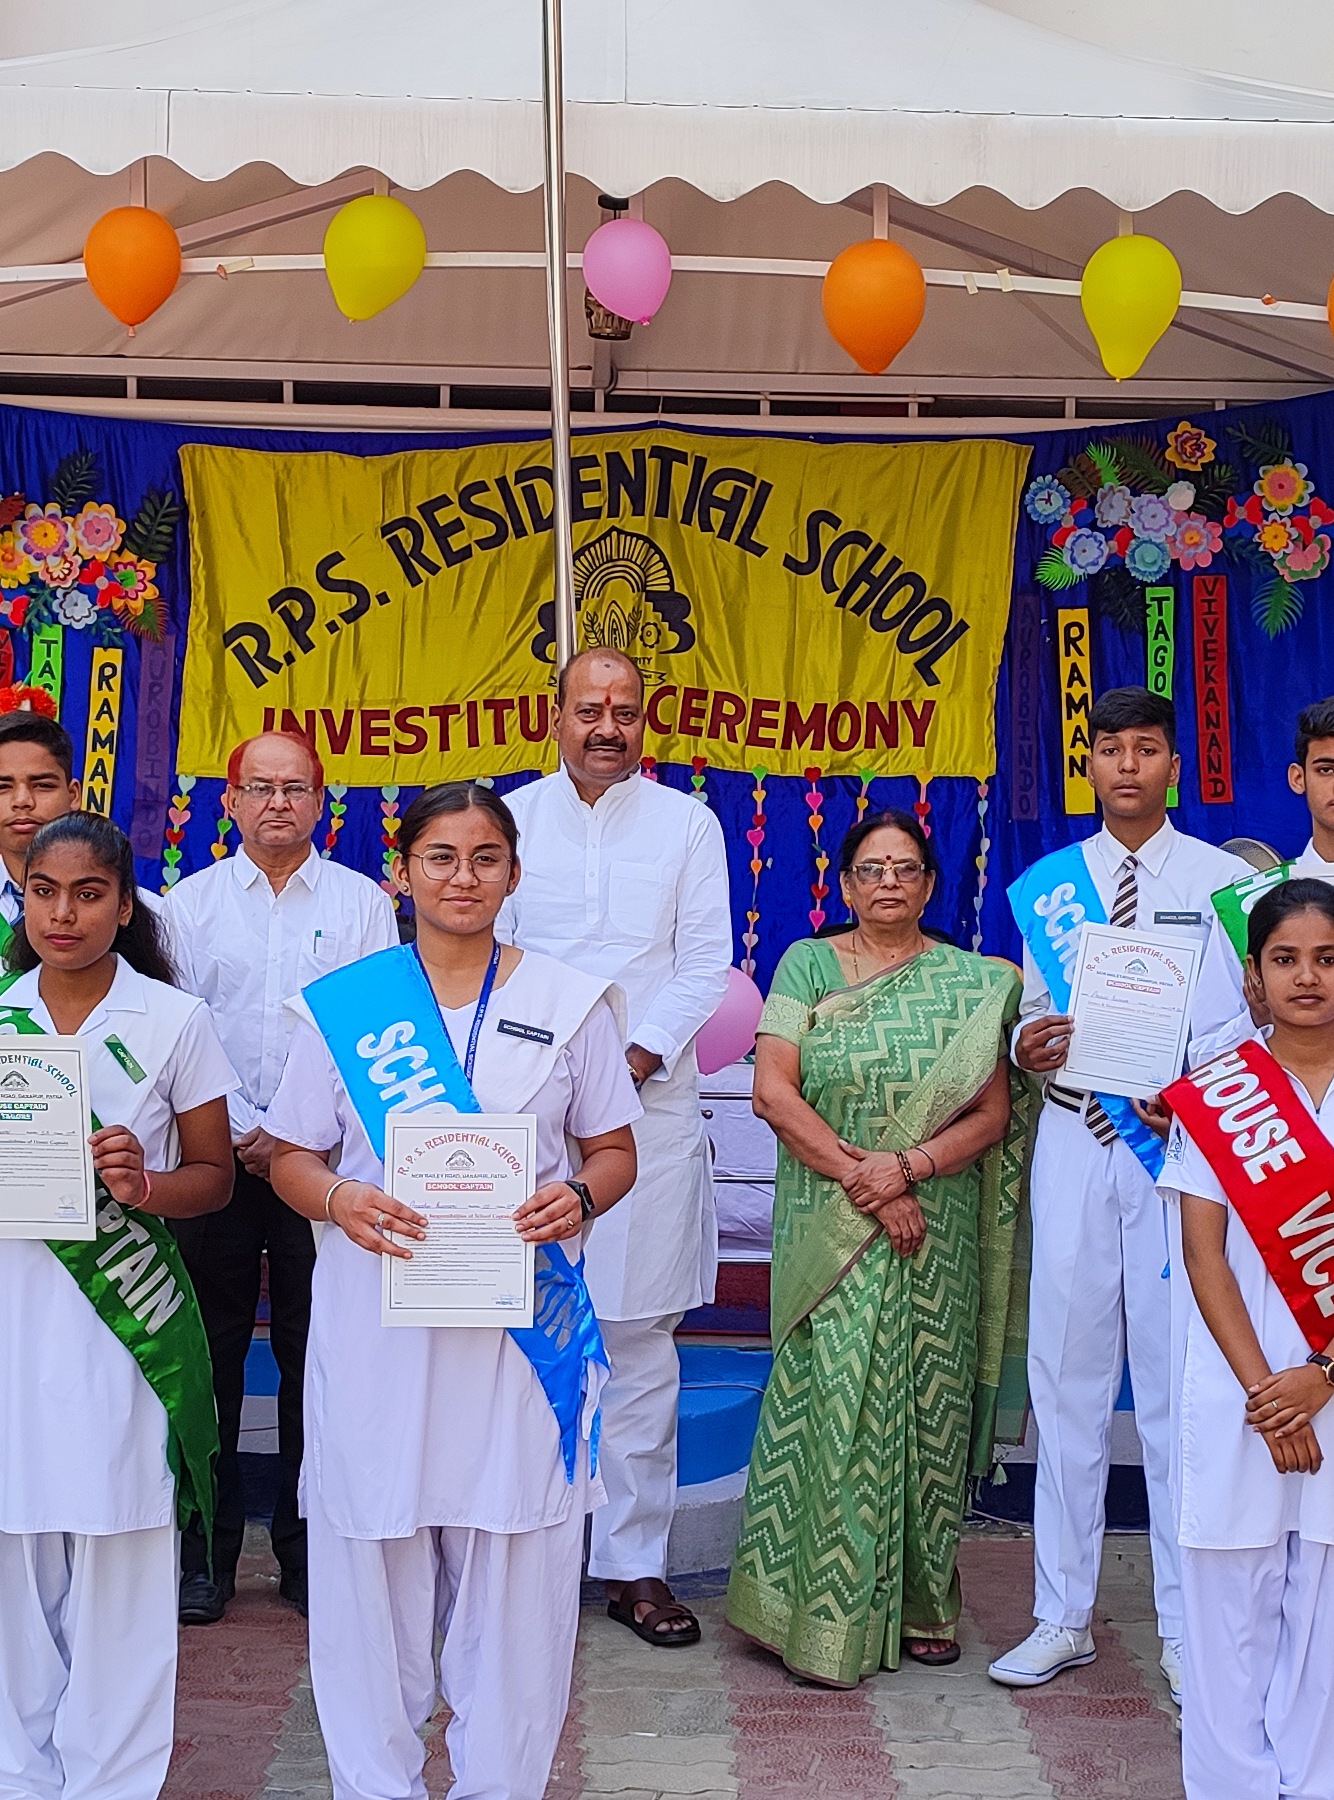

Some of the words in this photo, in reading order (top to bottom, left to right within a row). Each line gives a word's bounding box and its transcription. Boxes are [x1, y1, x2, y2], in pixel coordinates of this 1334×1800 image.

[223, 551, 391, 688] R.P.S.
[380, 445, 773, 586] RESIDENTIAL
[783, 509, 970, 687] SCHOOL
[1063, 621, 1090, 778] RAMAN
[1150, 596, 1171, 693] TAGO
[1200, 578, 1226, 797] VIVEKANAND
[87, 662, 117, 812] RAMAN
[262, 695, 556, 756] INVESTITU
[646, 685, 936, 752] CEREMONY
[1033, 882, 1086, 985] SCH
[45, 1064, 78, 1097] SCHOOL
[356, 1021, 458, 1113] SCH
[1187, 1050, 1306, 1183] HOUSE
[425, 1133, 490, 1149] RESIDENTIAL
[492, 1143, 524, 1176] SCHOOL
[96, 1195, 185, 1336] PTAIN
